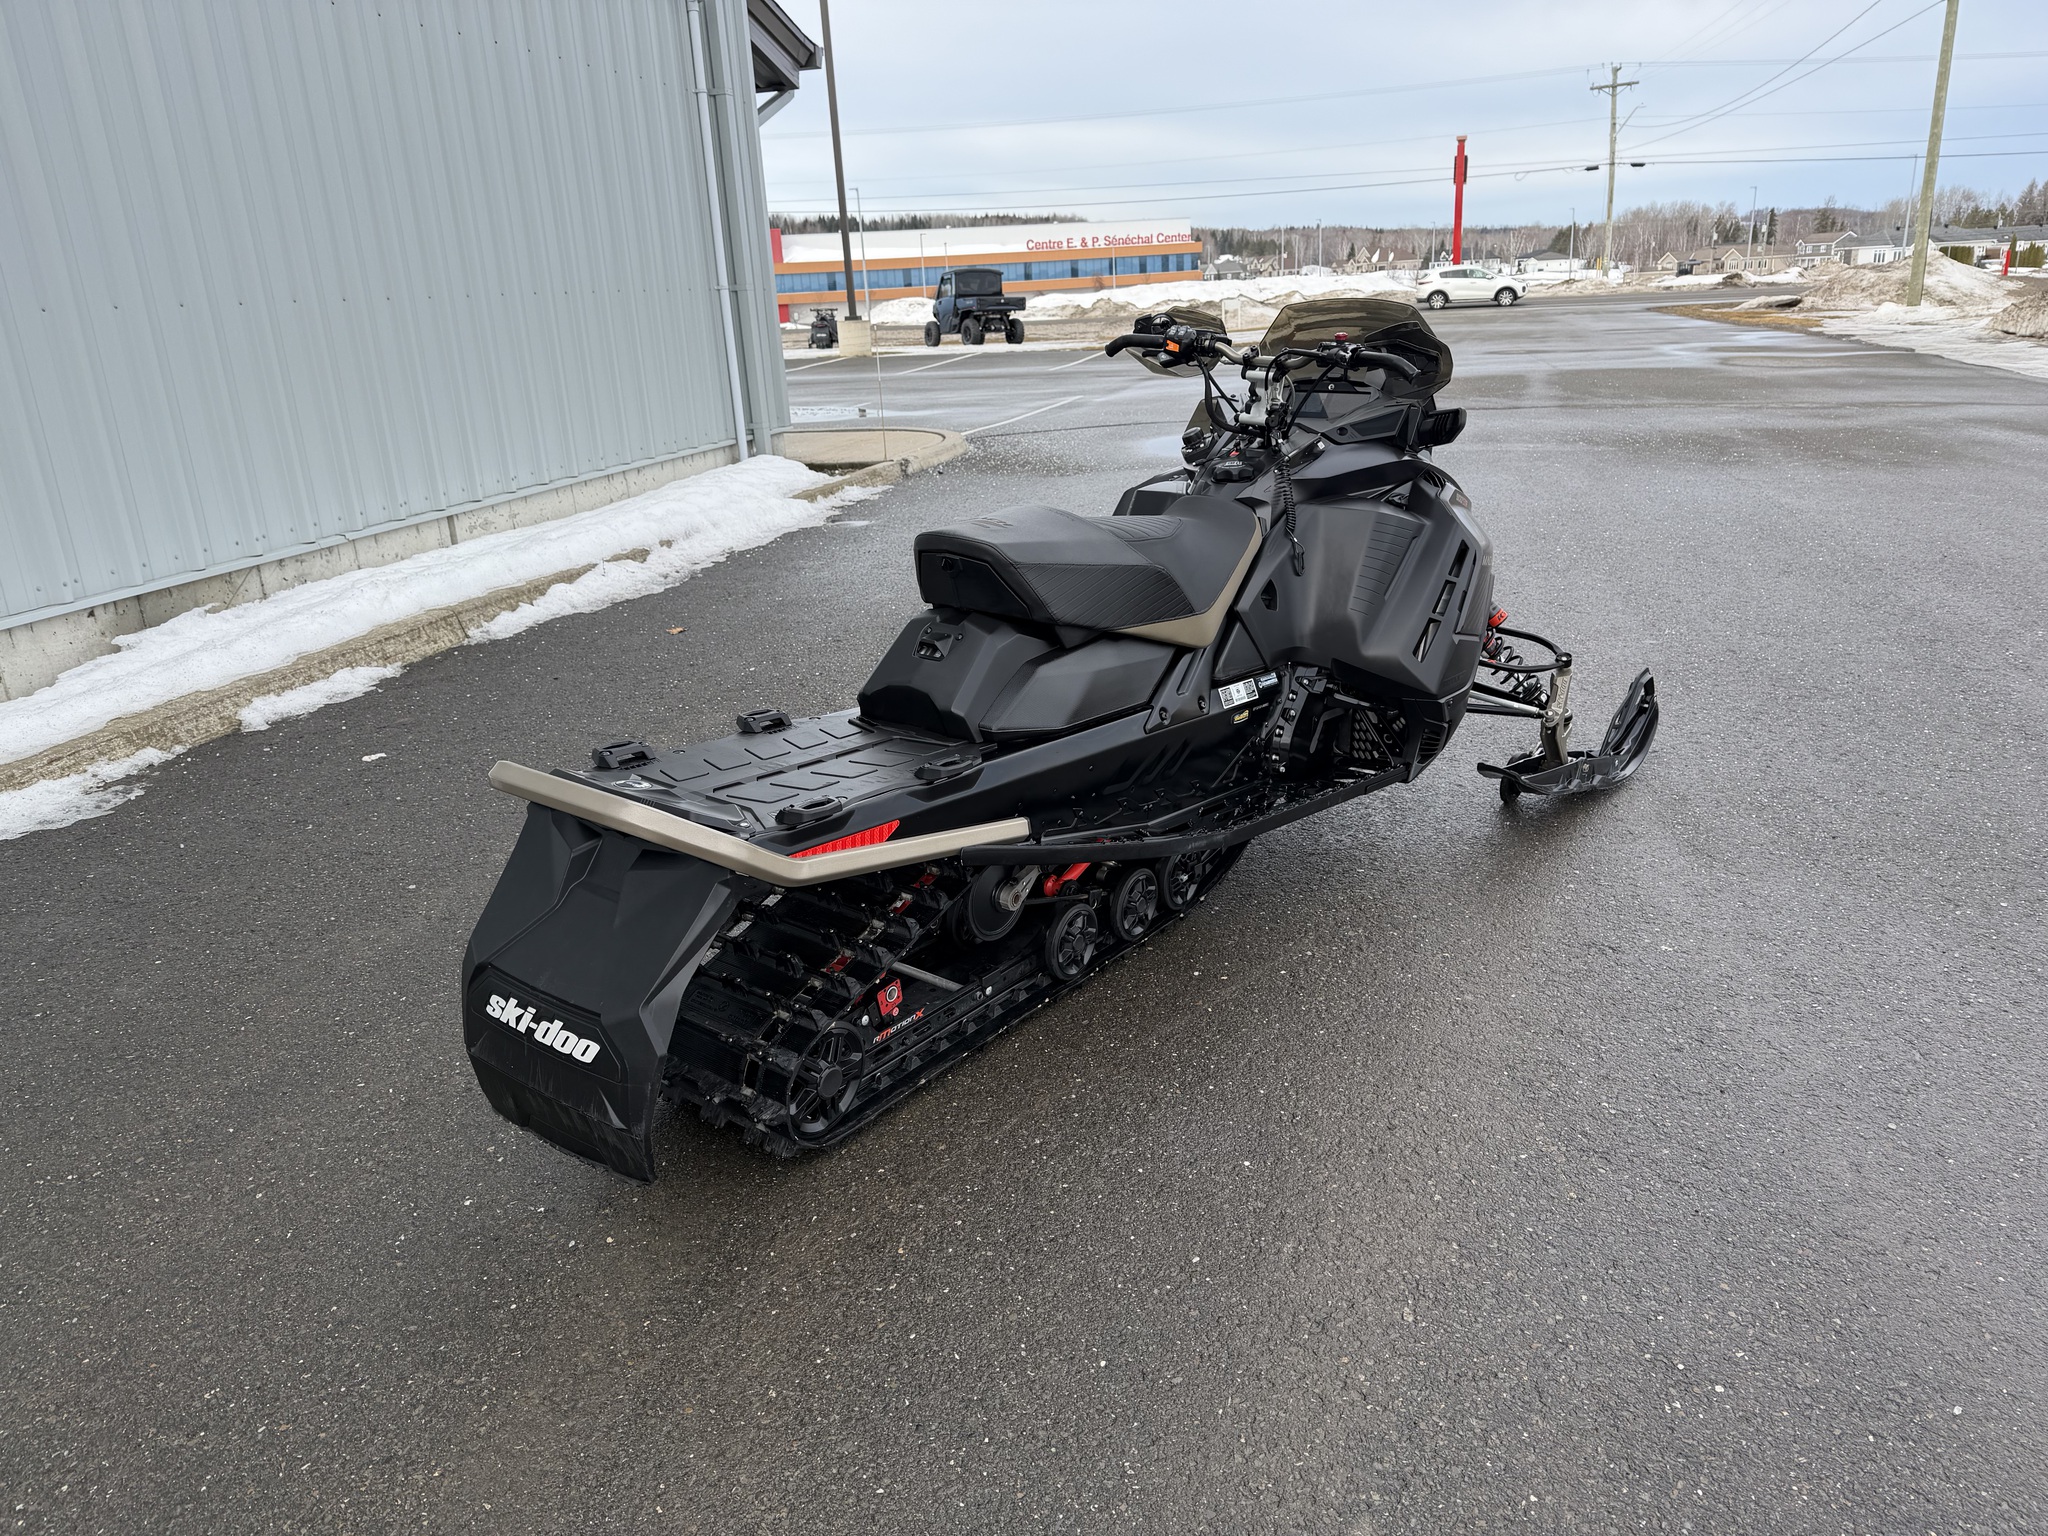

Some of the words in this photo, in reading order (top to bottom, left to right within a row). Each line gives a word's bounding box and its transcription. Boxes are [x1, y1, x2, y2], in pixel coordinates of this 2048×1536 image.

[1026, 238, 1064, 251] Centre
[1066, 237, 1078, 249] E.
[1080, 236, 1089, 248] &
[1091, 236, 1102, 248] P.
[1103, 233, 1154, 247] Sénéchal
[1156, 232, 1192, 243] Center
[485, 994, 601, 1064] ski-doo
